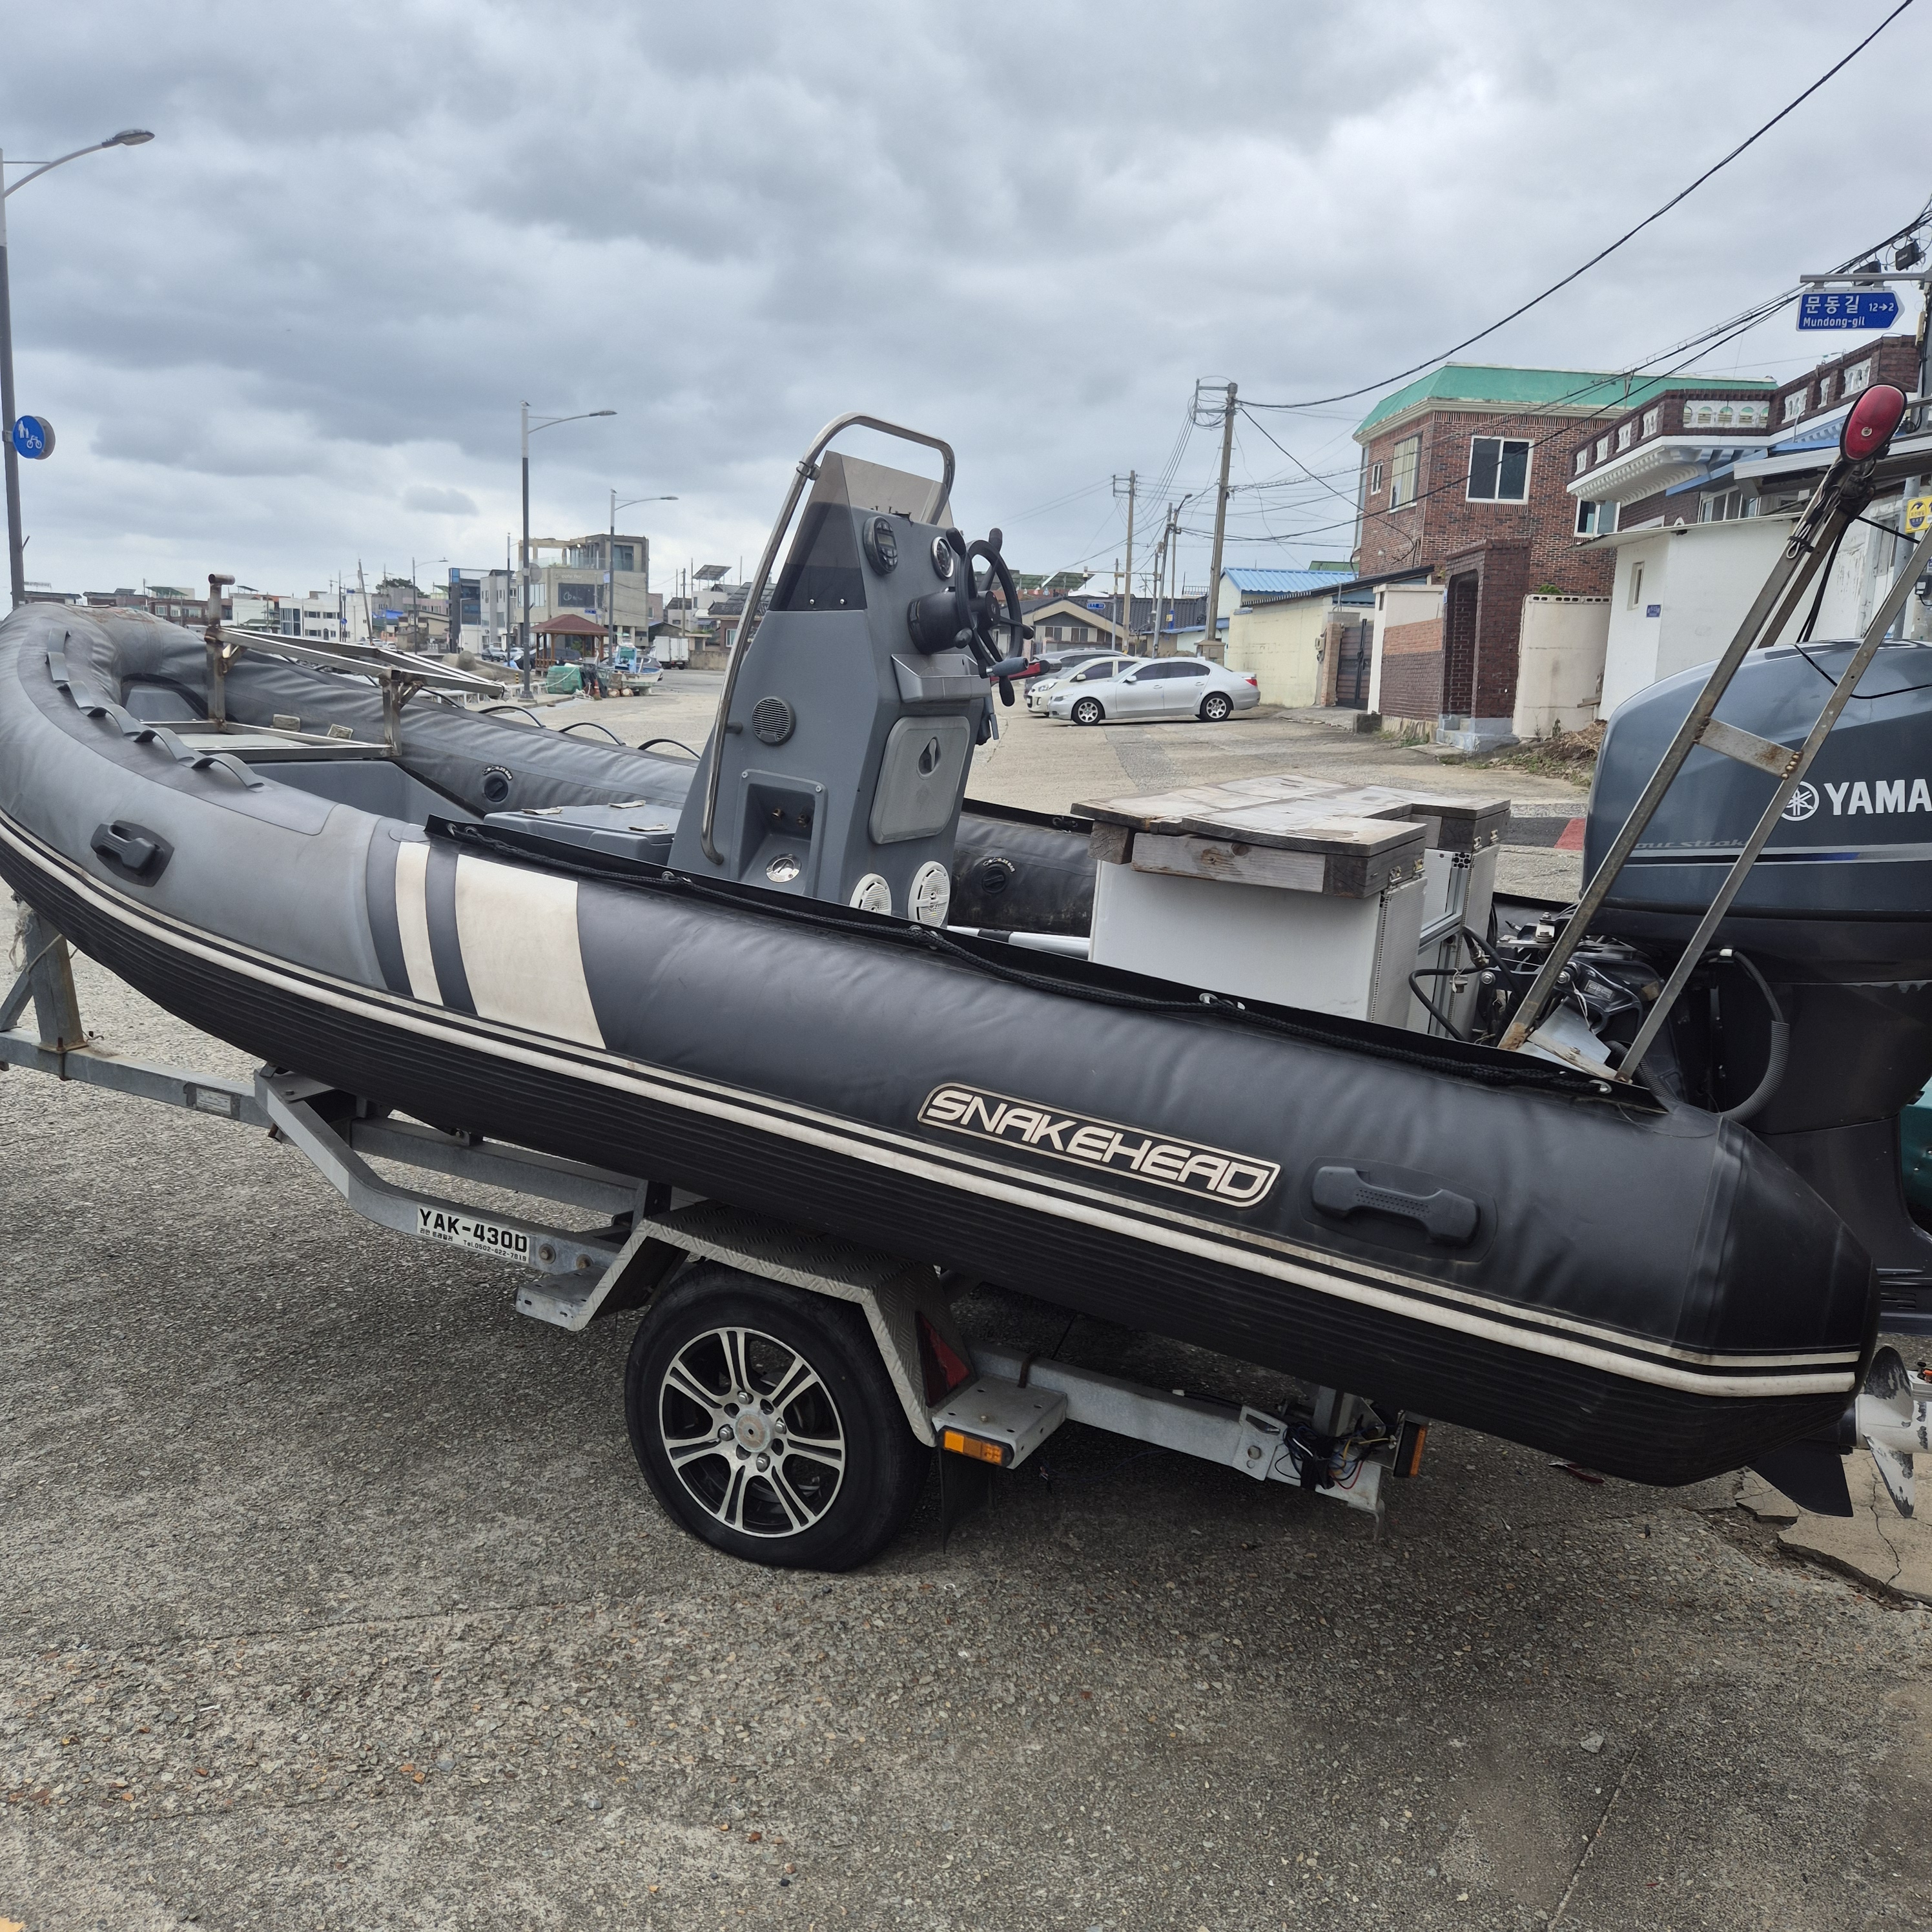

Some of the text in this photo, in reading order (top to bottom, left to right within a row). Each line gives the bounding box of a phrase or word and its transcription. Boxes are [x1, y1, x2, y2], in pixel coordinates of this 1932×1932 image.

[1805, 295, 1860, 314] 문동길
[1803, 316, 1865, 328] Mundong-gil
[1824, 779, 1932, 816] YAMA
[927, 1090, 1270, 1198] SNAKEHEAD
